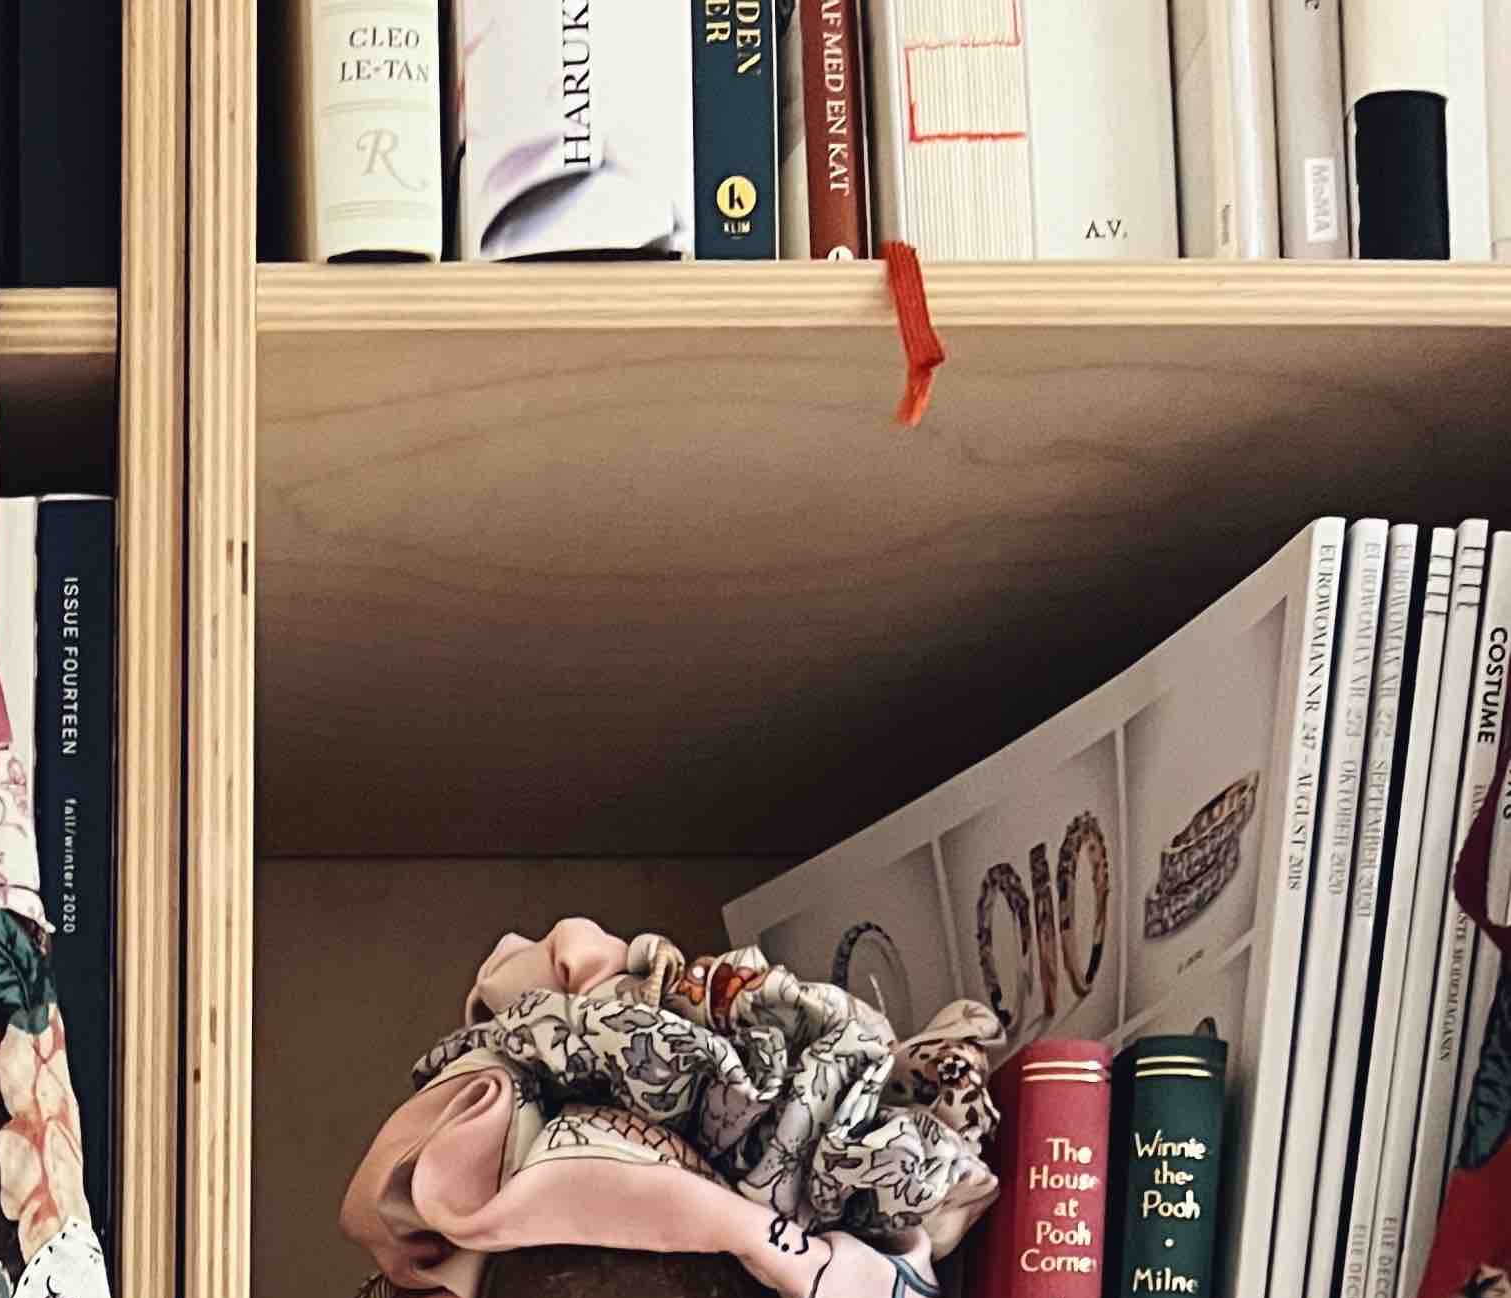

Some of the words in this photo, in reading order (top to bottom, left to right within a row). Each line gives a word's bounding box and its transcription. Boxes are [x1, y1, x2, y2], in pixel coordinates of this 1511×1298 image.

[347, 28, 420, 49] CLEO
[337, 59, 430, 84] LE-TAN
[821, 32, 845, 91] MED
[825, 100, 848, 135] EN
[356, 129, 427, 191] R
[828, 143, 851, 195] KAT
[1311, 164, 1331, 234] MoMA
[723, 221, 751, 233] KLIM
[1085, 219, 1128, 241] A.V.
[63, 577, 79, 638] ISSUE
[1308, 544, 1336, 678] EUROWOMAN
[62, 646, 78, 754] FOURTEEN
[1478, 627, 1508, 744] COSTUME
[1291, 771, 1312, 848] AUGUST
[1332, 760, 1355, 847] OKTOBER
[64, 799, 76, 888] fall/winter
[1288, 855, 1305, 891] 2018
[64, 894, 76, 933] 2020
[1046, 1137, 1092, 1163] The
[1029, 1165, 1100, 1190] House
[1054, 1198, 1079, 1218] at
[1143, 1190, 1200, 1219] Pooh
[1036, 1220, 1091, 1246] Pooh
[1351, 1225, 1367, 1255] ELLE
[1382, 1217, 1398, 1248] ELLE
[1133, 1267, 1197, 1293] Milne
